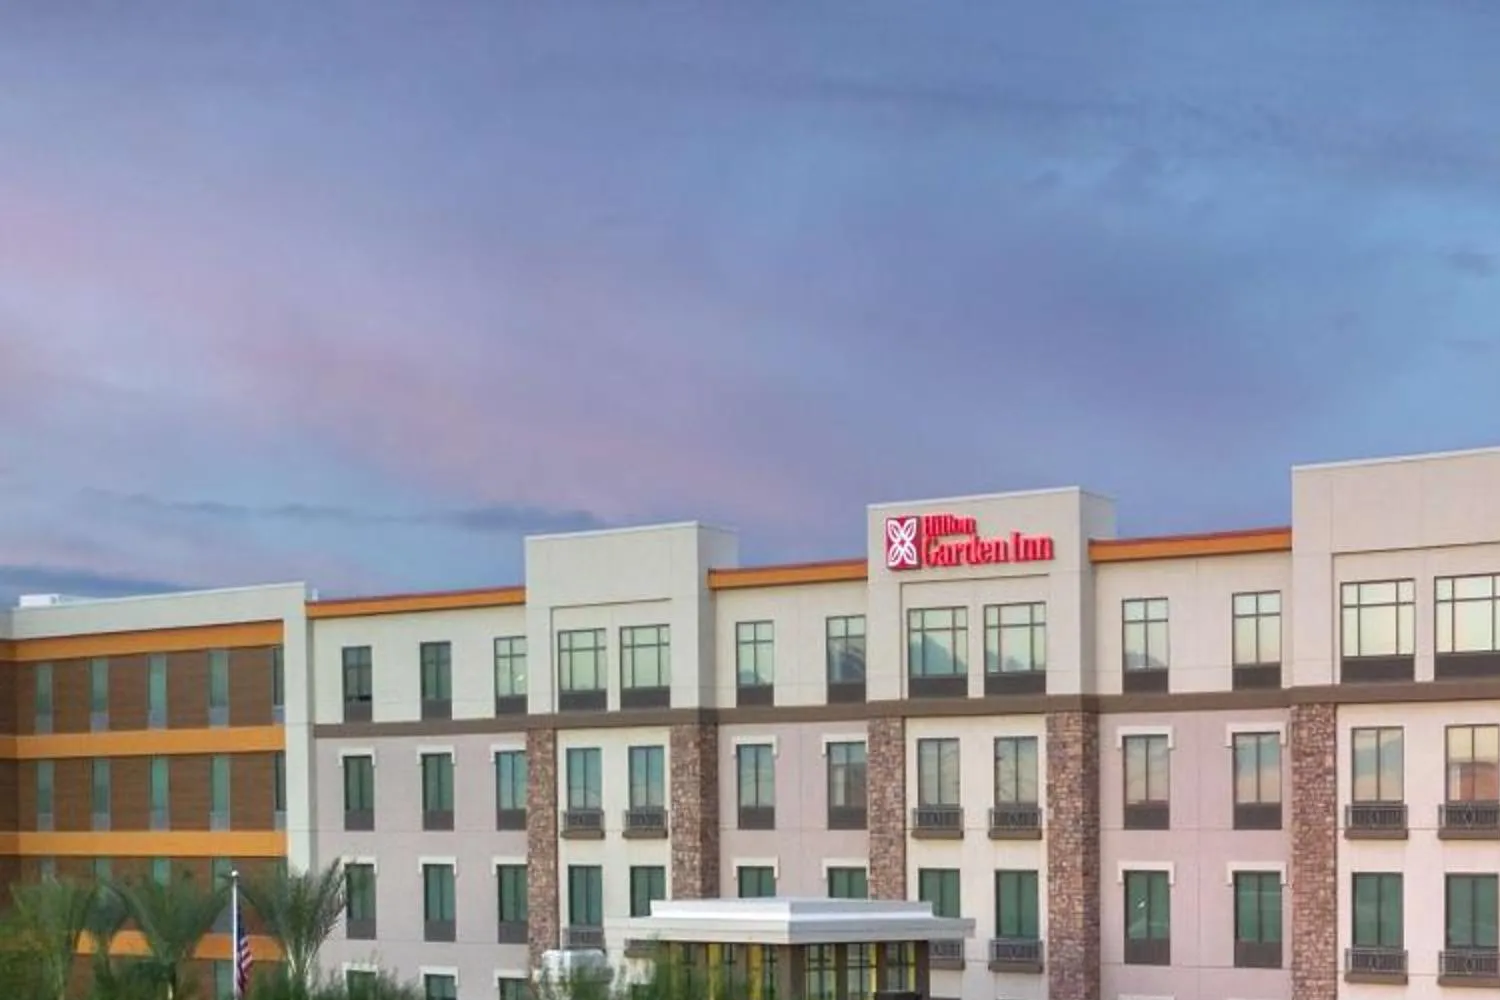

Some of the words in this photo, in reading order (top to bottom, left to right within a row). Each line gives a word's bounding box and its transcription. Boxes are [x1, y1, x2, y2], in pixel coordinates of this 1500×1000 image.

[923, 513, 976, 537] Hilton
[923, 535, 1008, 567] Garden
[1010, 530, 1055, 561] Inn
